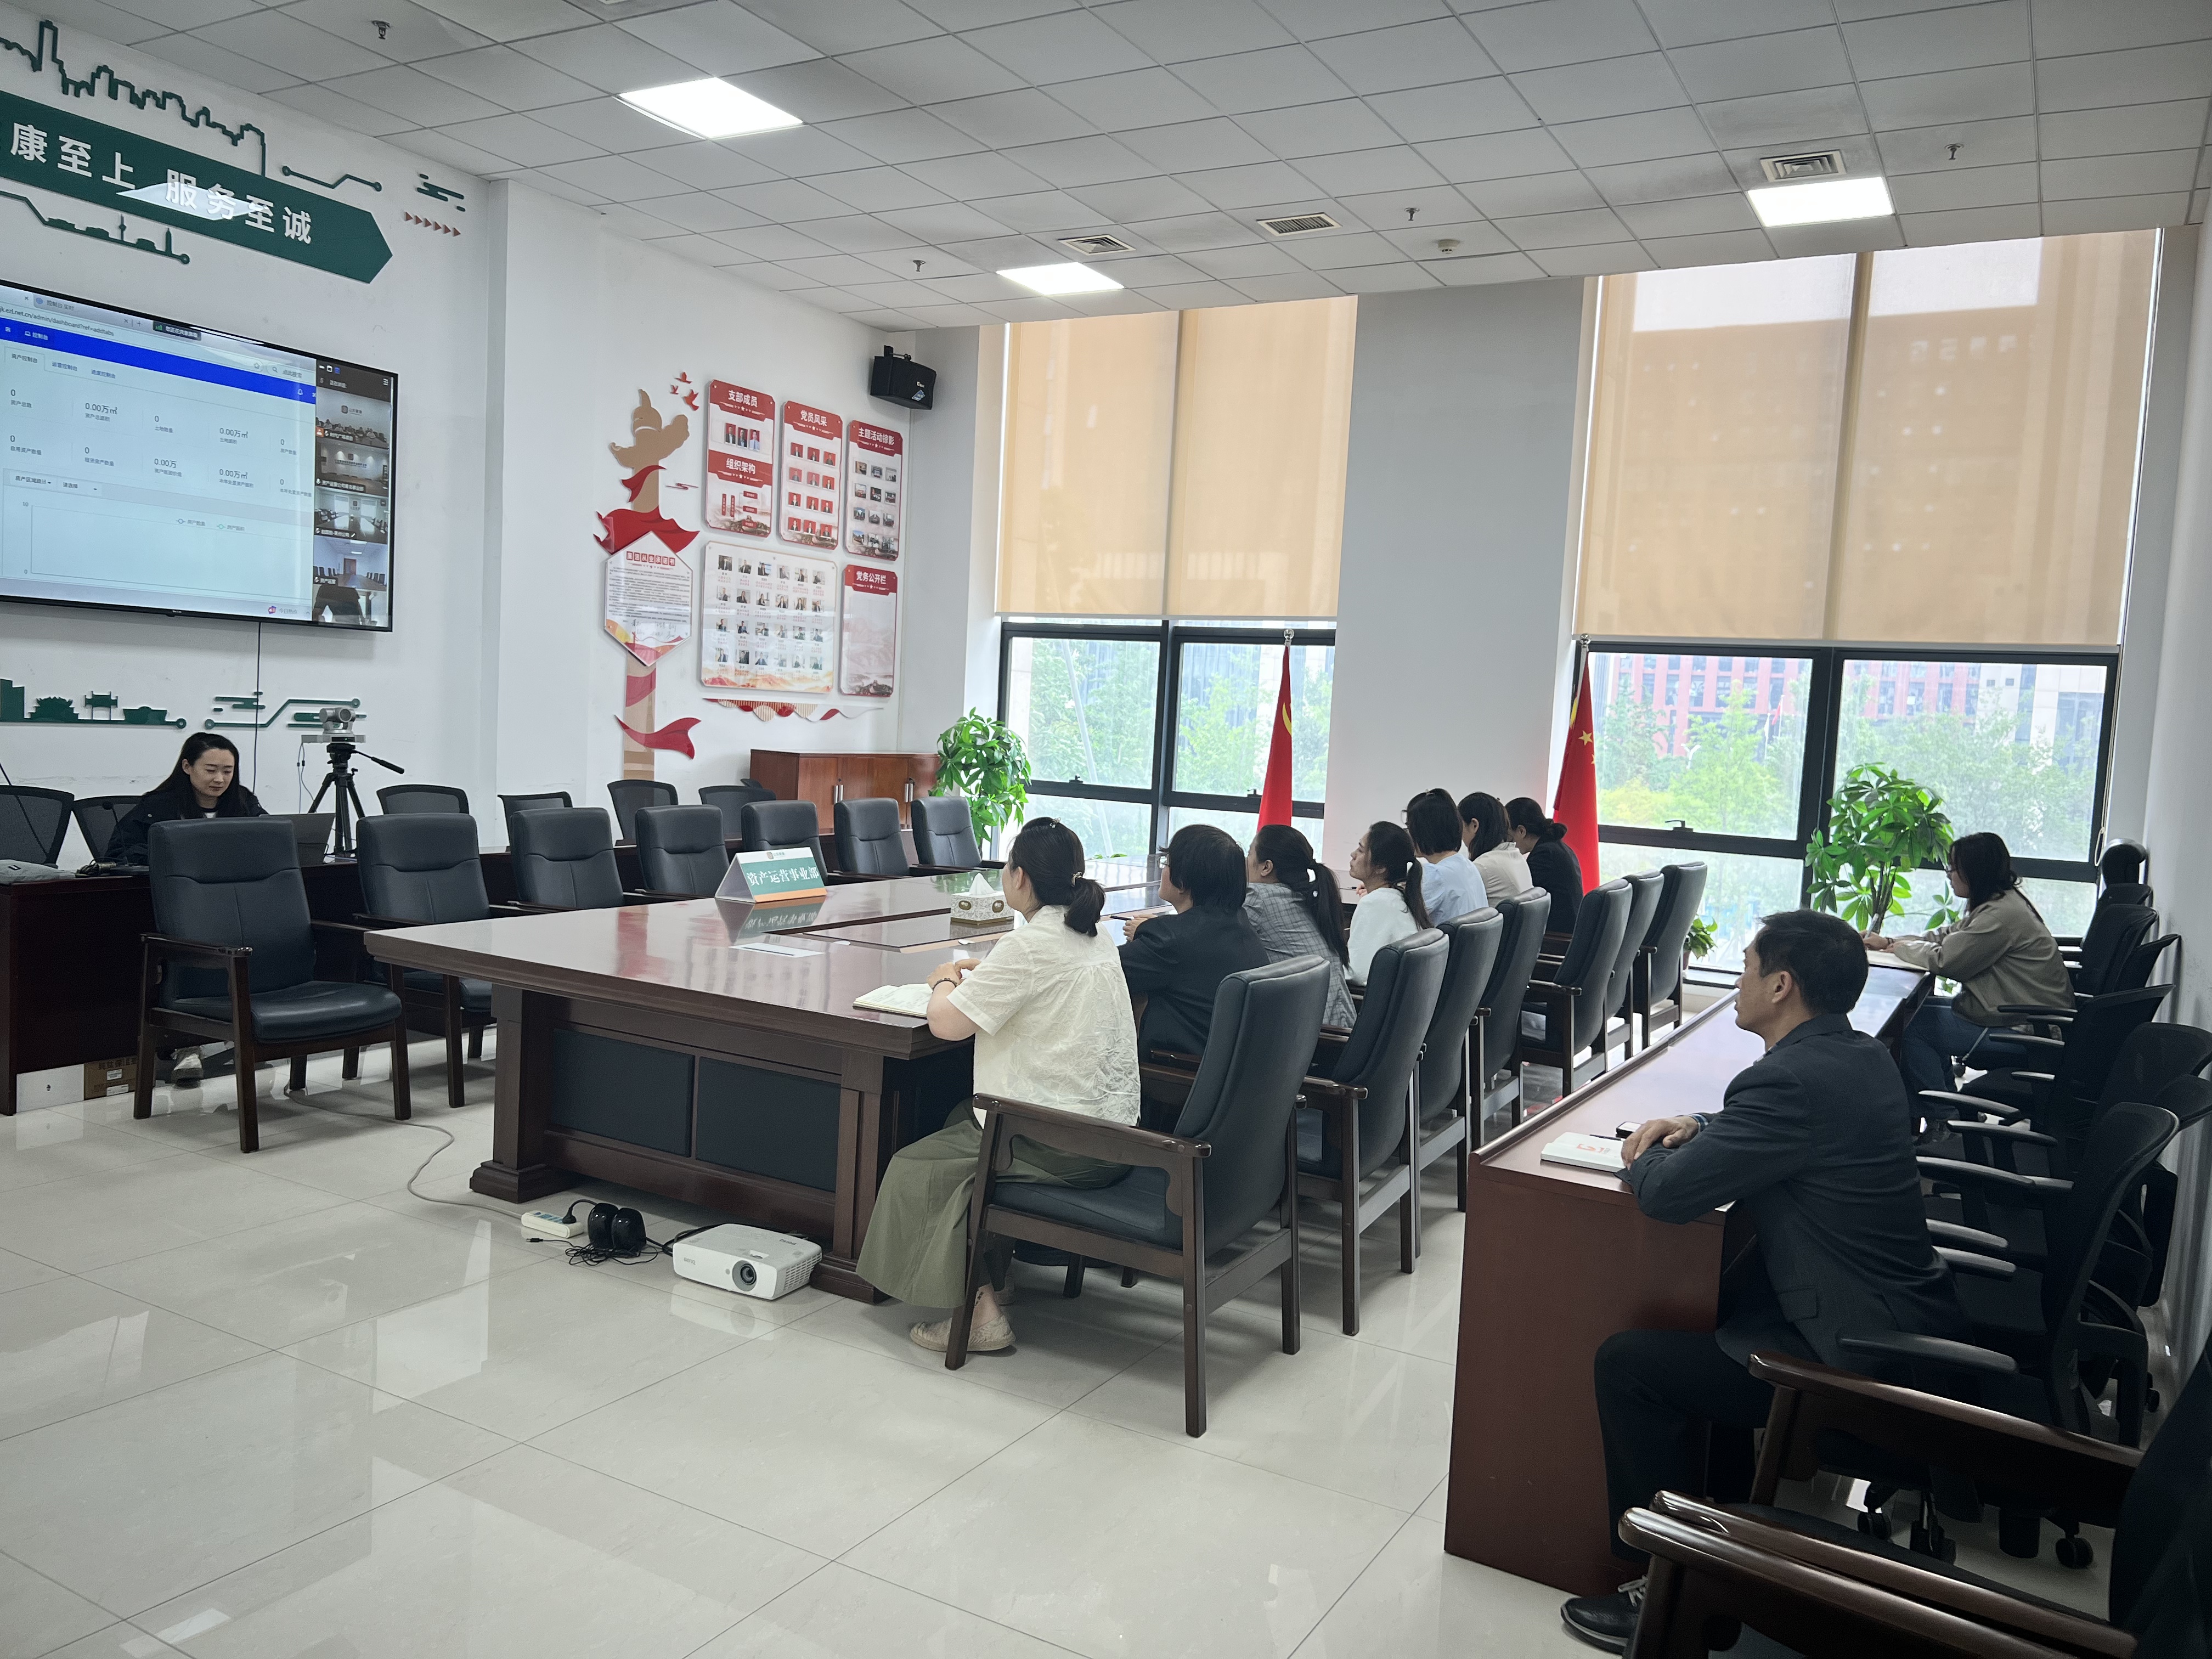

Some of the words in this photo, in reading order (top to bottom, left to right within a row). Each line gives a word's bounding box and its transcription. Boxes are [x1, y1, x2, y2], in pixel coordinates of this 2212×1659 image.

[165, 168, 312, 244] 服务至诚
[728, 390, 758, 408] 支部成员
[800, 410, 827, 427] 党员风采
[858, 427, 895, 445] 主题活动掠影
[726, 458, 756, 475] 组织架构
[856, 571, 887, 585] 党务公开栏
[746, 866, 819, 886] 资产运营事业部
